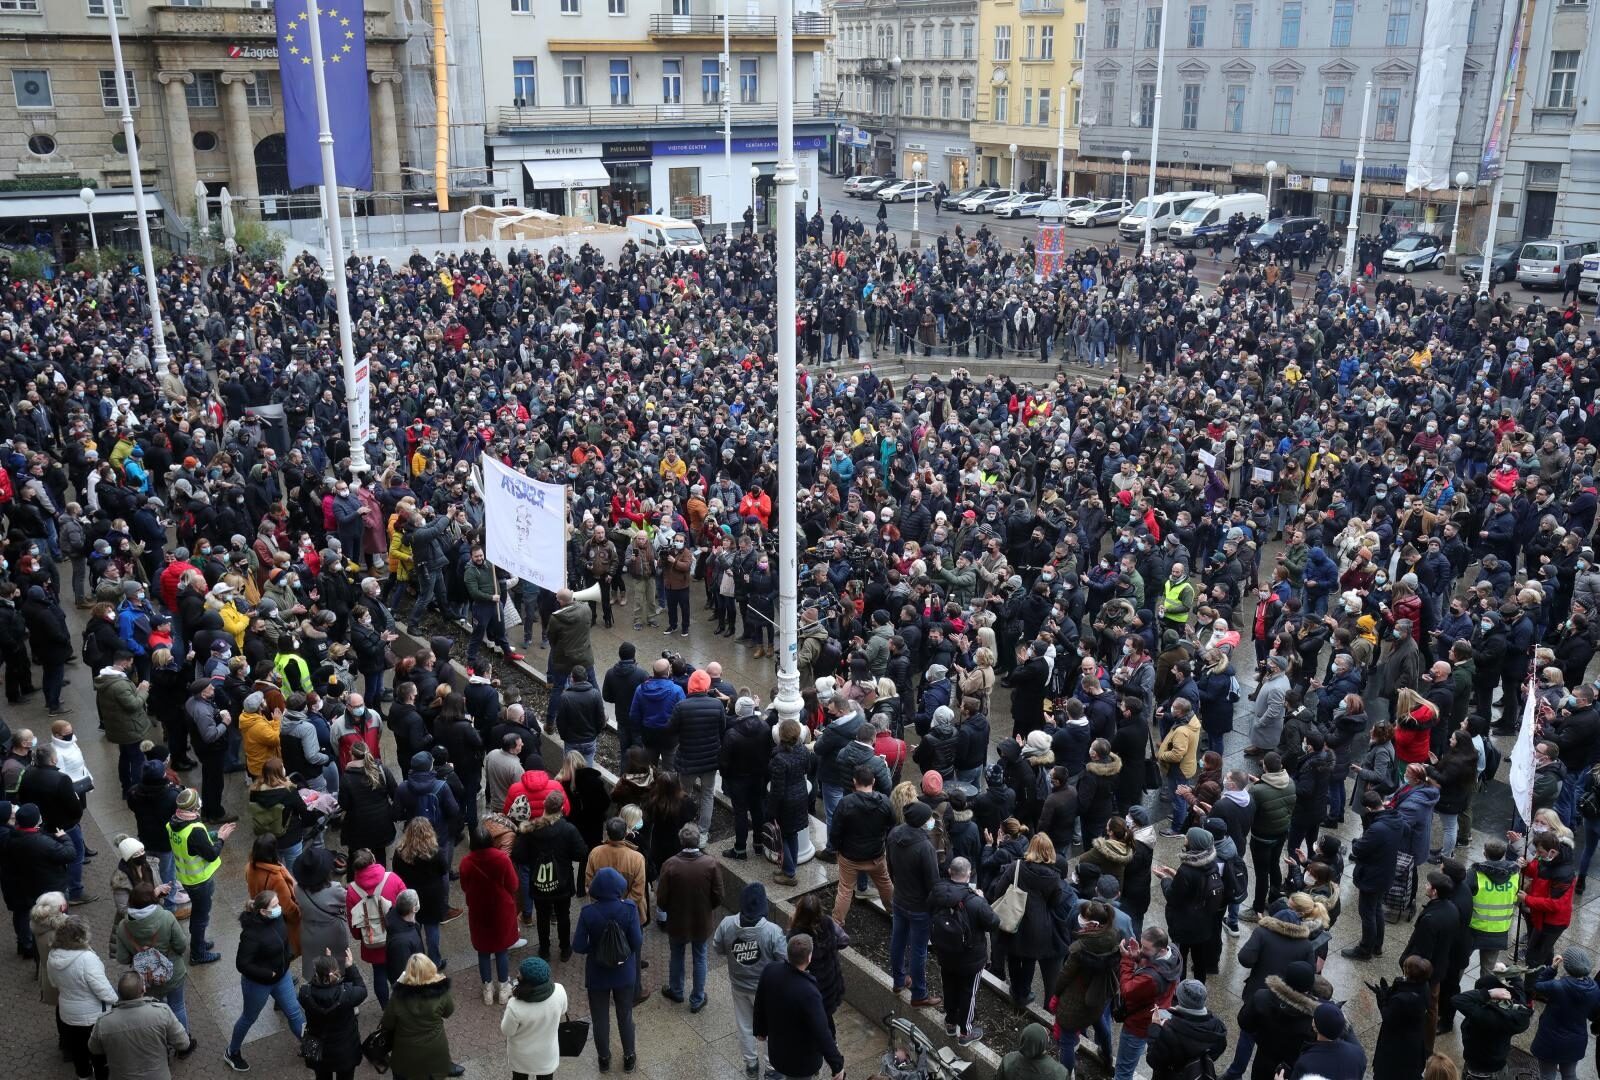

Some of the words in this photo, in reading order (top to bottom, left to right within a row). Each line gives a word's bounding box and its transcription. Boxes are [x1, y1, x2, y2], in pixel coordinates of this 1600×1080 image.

[1485, 880, 1513, 892] UGP
[732, 940, 758, 952] SANTA
[736, 950, 758, 962] CRUZ
